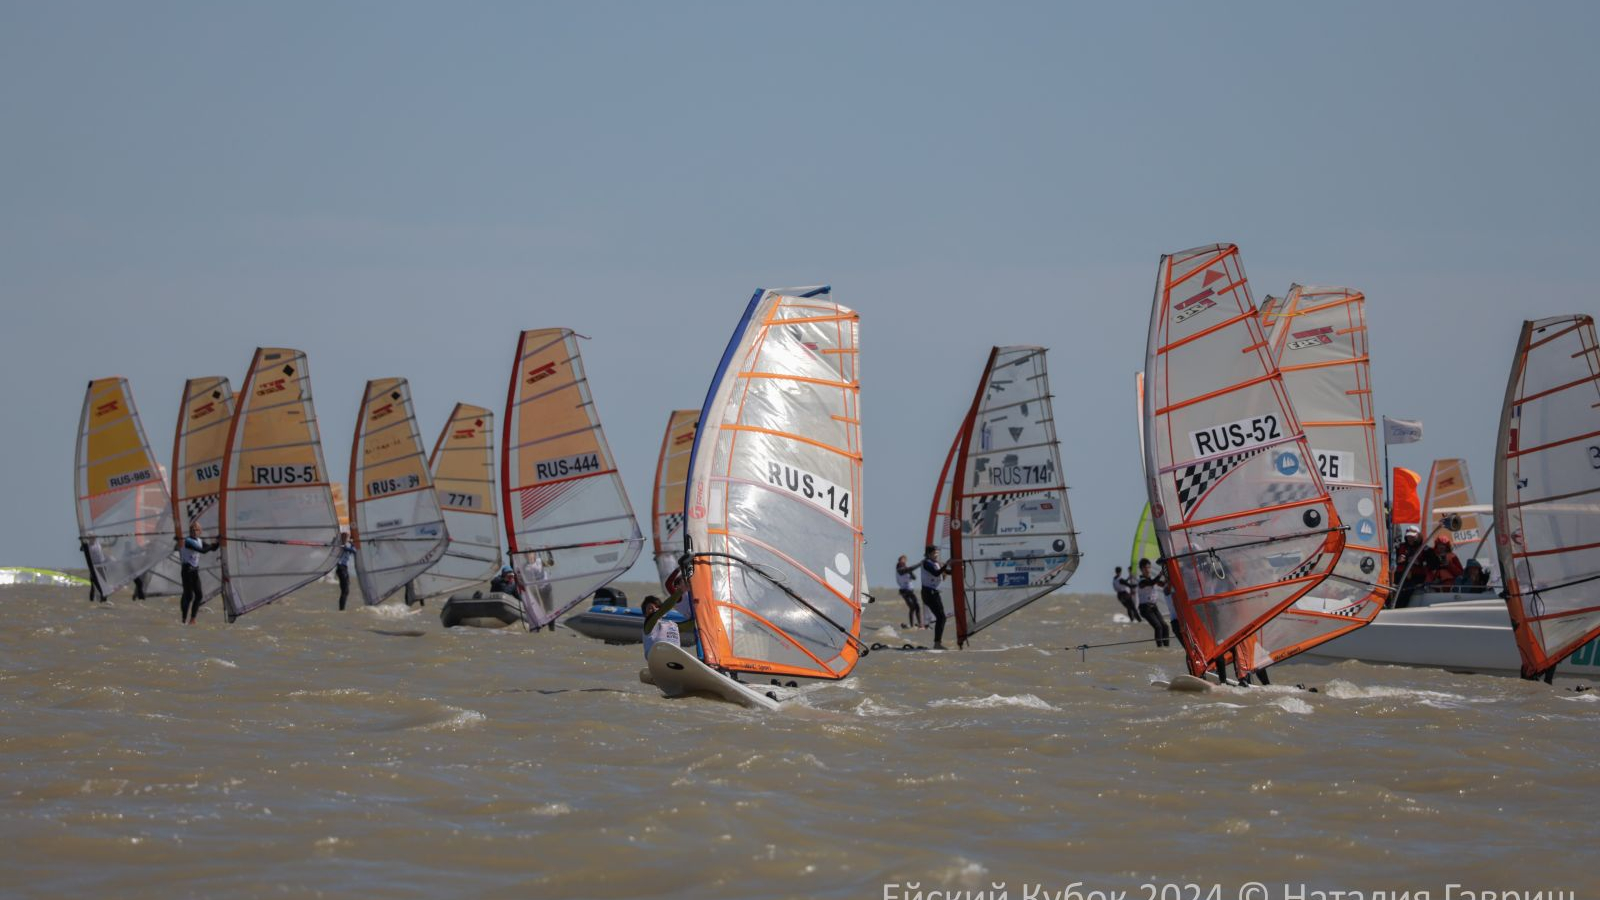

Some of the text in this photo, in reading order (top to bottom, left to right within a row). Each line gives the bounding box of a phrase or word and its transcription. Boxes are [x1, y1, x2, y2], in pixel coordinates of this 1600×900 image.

[1195, 415, 1281, 455] RUS-52
[536, 453, 599, 479] RUS-444
[448, 493, 472, 506] 771
[768, 461, 850, 518] RUS-14
